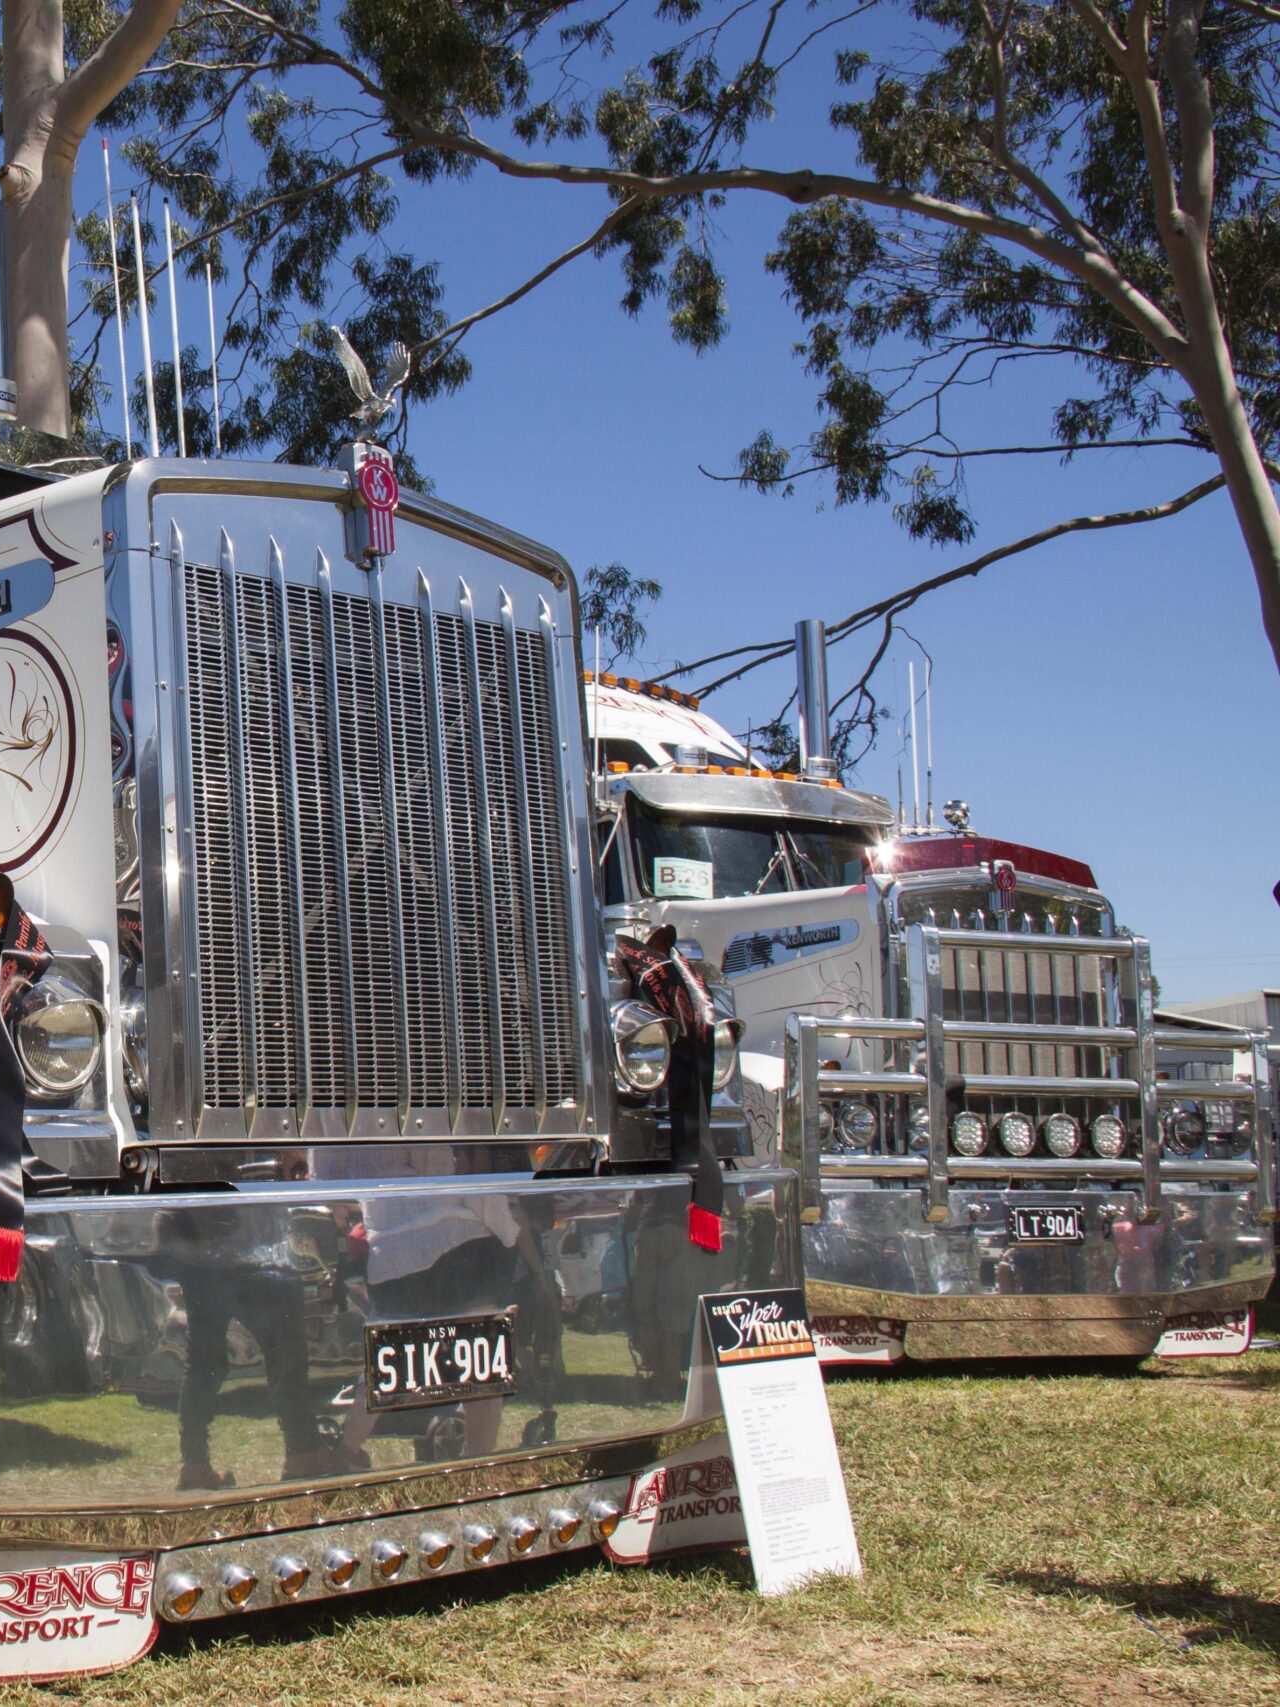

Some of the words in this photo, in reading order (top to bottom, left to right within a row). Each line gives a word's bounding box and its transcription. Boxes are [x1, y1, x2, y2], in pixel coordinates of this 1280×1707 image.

[428, 1326, 457, 1339] NSW
[718, 1298, 784, 1353] Super
[753, 1319, 811, 1347] TRUCK
[812, 1316, 905, 1341] AWRENCE
[1174, 1331, 1225, 1342] TRANSPORT
[820, 1336, 878, 1347] TRANSPORT
[621, 1456, 740, 1519] LAWREN
[657, 1496, 743, 1526] TRANSPOR
